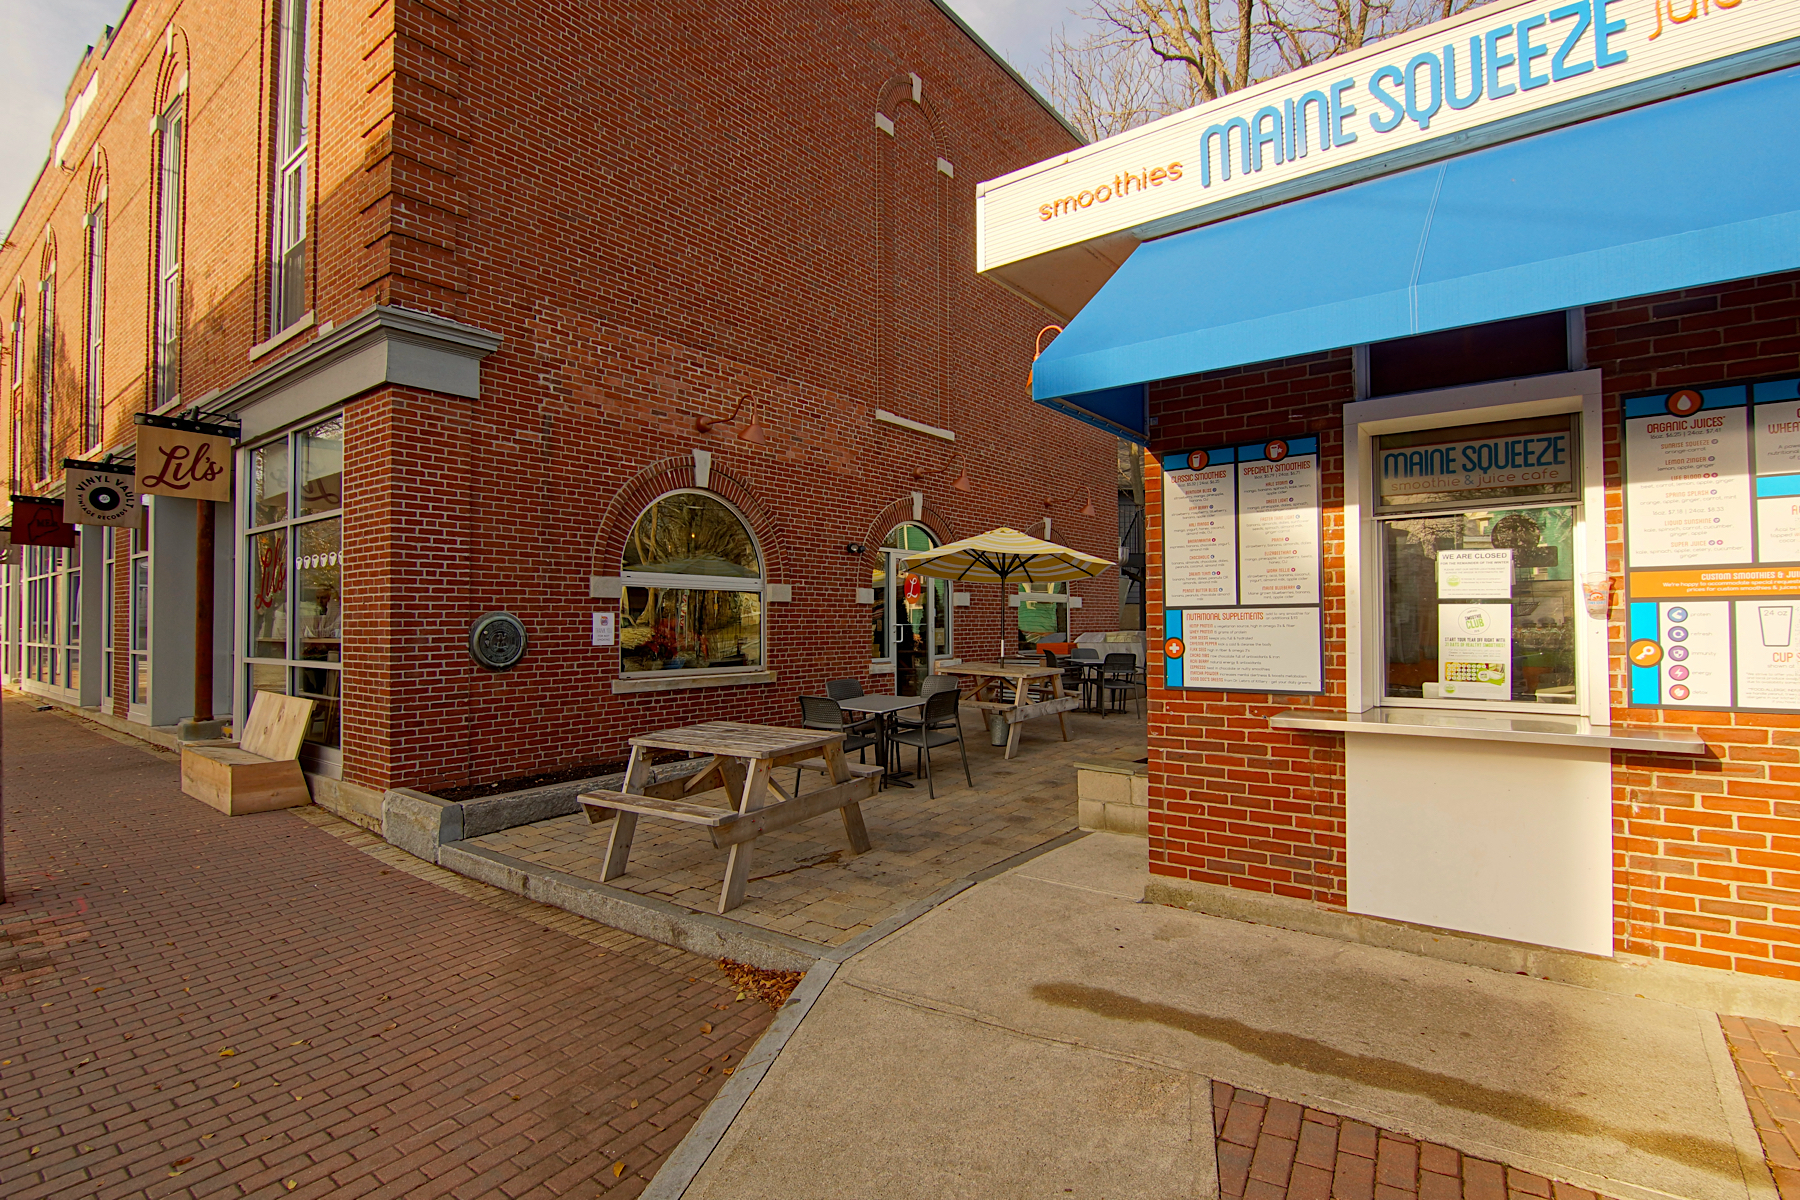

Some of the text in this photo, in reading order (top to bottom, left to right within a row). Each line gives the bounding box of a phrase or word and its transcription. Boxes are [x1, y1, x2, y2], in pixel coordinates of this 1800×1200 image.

[1200, 0, 1629, 188] MAINE SQUEEZE
[1038, 160, 1183, 221] smoothies
[1647, 420, 1688, 434] ORGANIC
[1384, 436, 1566, 479] MAINE SQUEEZE
[142, 442, 224, 490] Lil's
[1244, 460, 1311, 476] SPECIALTY SMOOTHIES
[1171, 470, 1227, 484] CLASSIC SMOOTHIES
[1391, 468, 1559, 491] smoothie & juice cafe
[75, 475, 135, 509] VINYL VAULT
[97, 508, 128, 520] RECORDS
[255, 538, 286, 610] Lil's
[1733, 571, 1775, 579] SMOOTHIES
[1222, 612, 1264, 620] SUPPLEMENTS
[1466, 618, 1484, 629] CLUB
[1772, 652, 1794, 662] CUP
